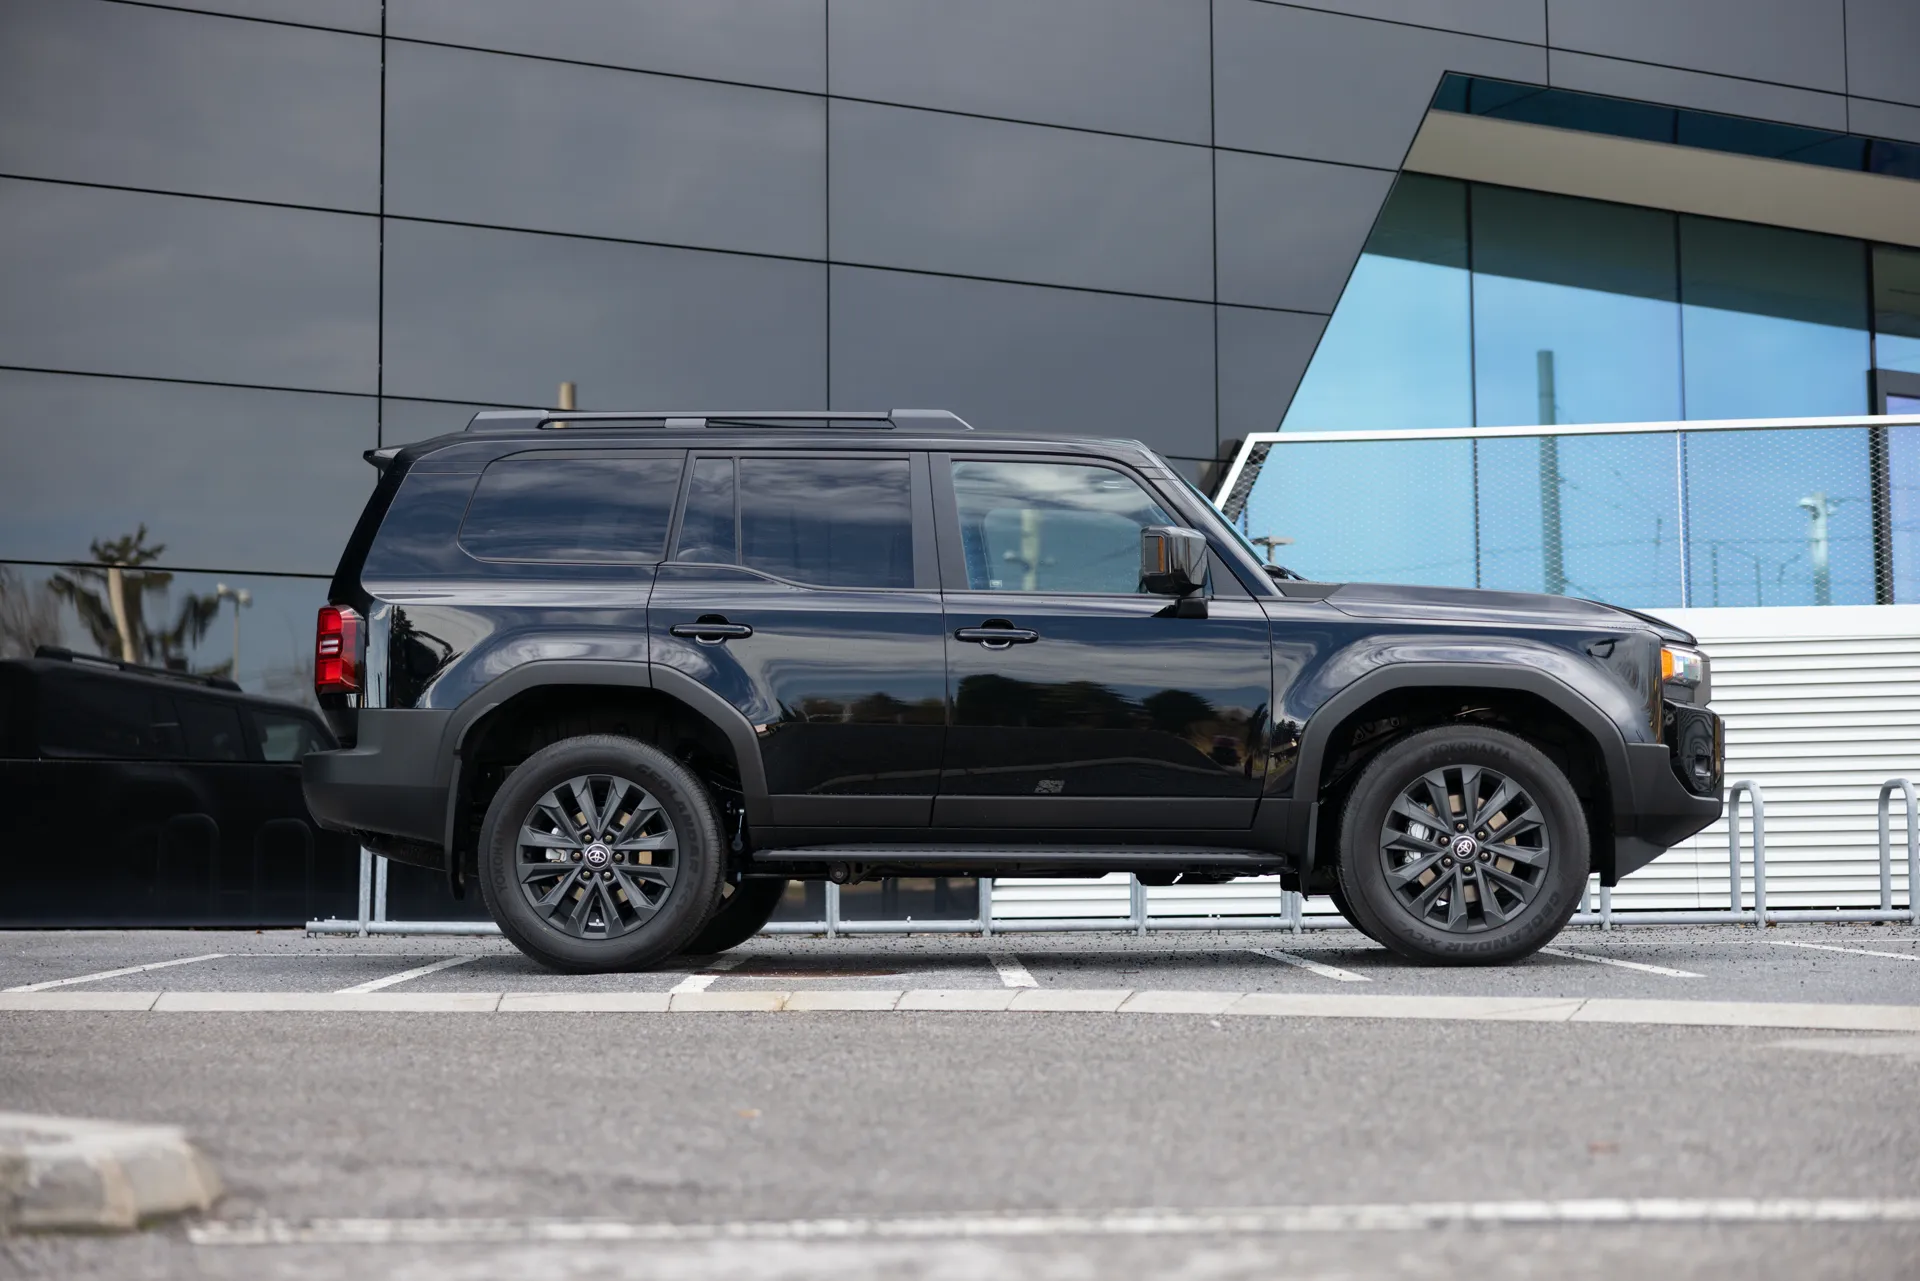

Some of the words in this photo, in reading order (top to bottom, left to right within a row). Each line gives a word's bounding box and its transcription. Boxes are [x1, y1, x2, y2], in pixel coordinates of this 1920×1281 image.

[1429, 742, 1510, 761] YOKOHAMA
[635, 763, 699, 873] GEOLANDAR
[1445, 891, 1560, 952] GEOLANDAR
